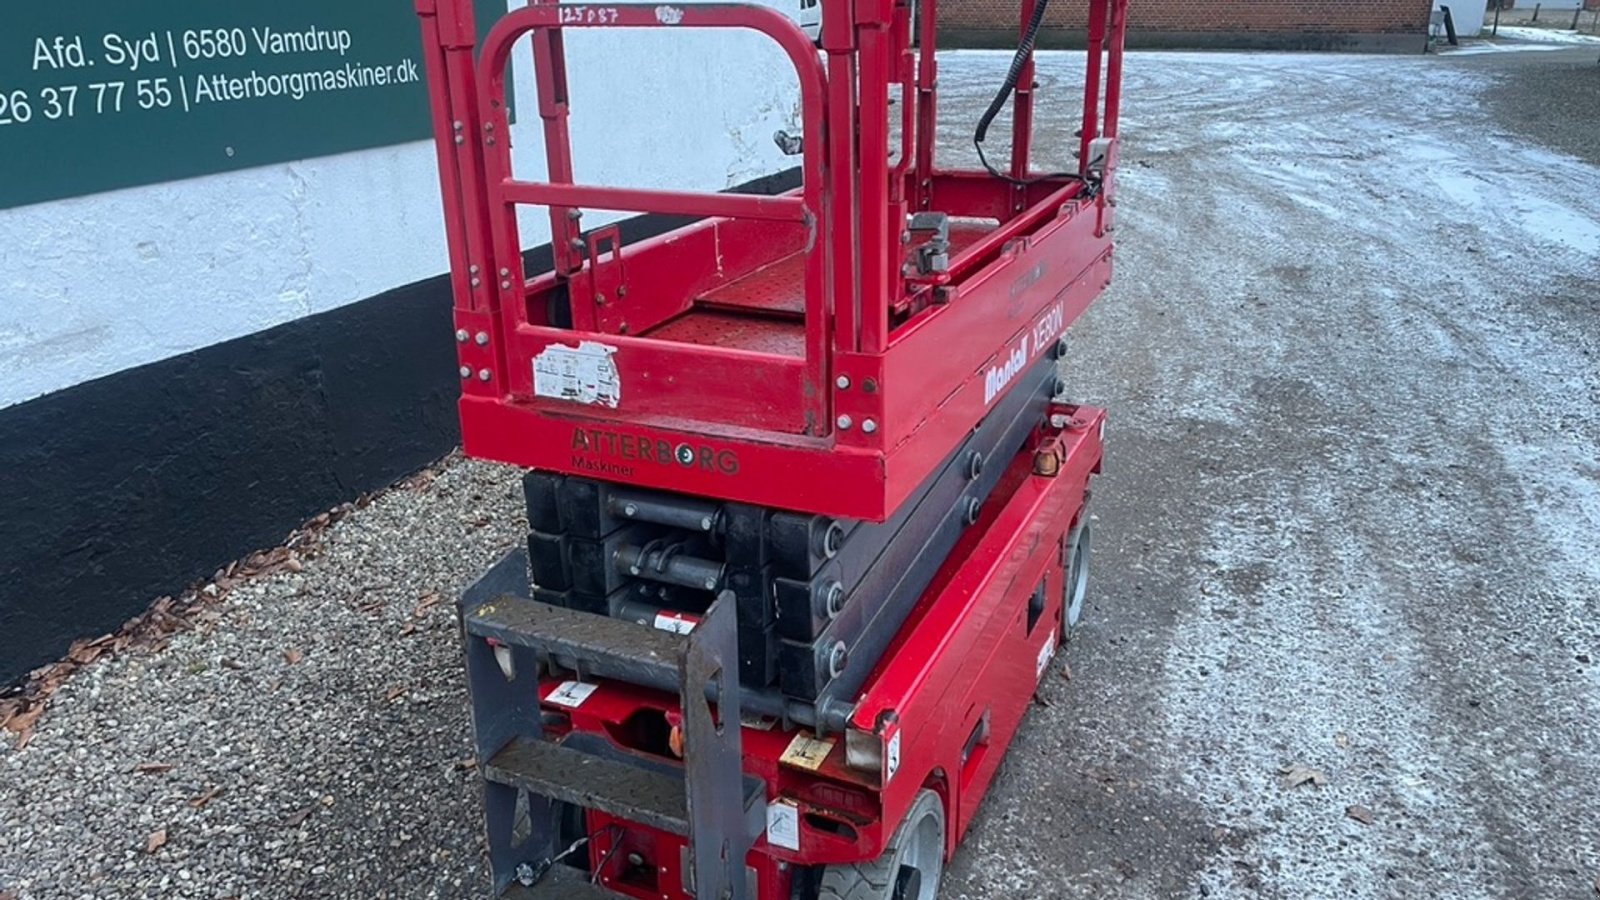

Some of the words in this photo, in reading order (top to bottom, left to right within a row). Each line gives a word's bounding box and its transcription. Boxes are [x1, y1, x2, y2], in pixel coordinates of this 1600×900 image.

[31, 35, 95, 71] Afd.
[104, 31, 160, 71] Syd
[183, 27, 247, 60] 6580
[252, 24, 352, 56] Vamdrup
[41, 85, 78, 119] 37
[88, 81, 125, 114] 77
[137, 77, 172, 109] 55
[194, 58, 420, 104] Atterborgmaskiner.dk
[571, 456, 635, 477] Maskiner
[572, 428, 740, 476] ATTERBORG
